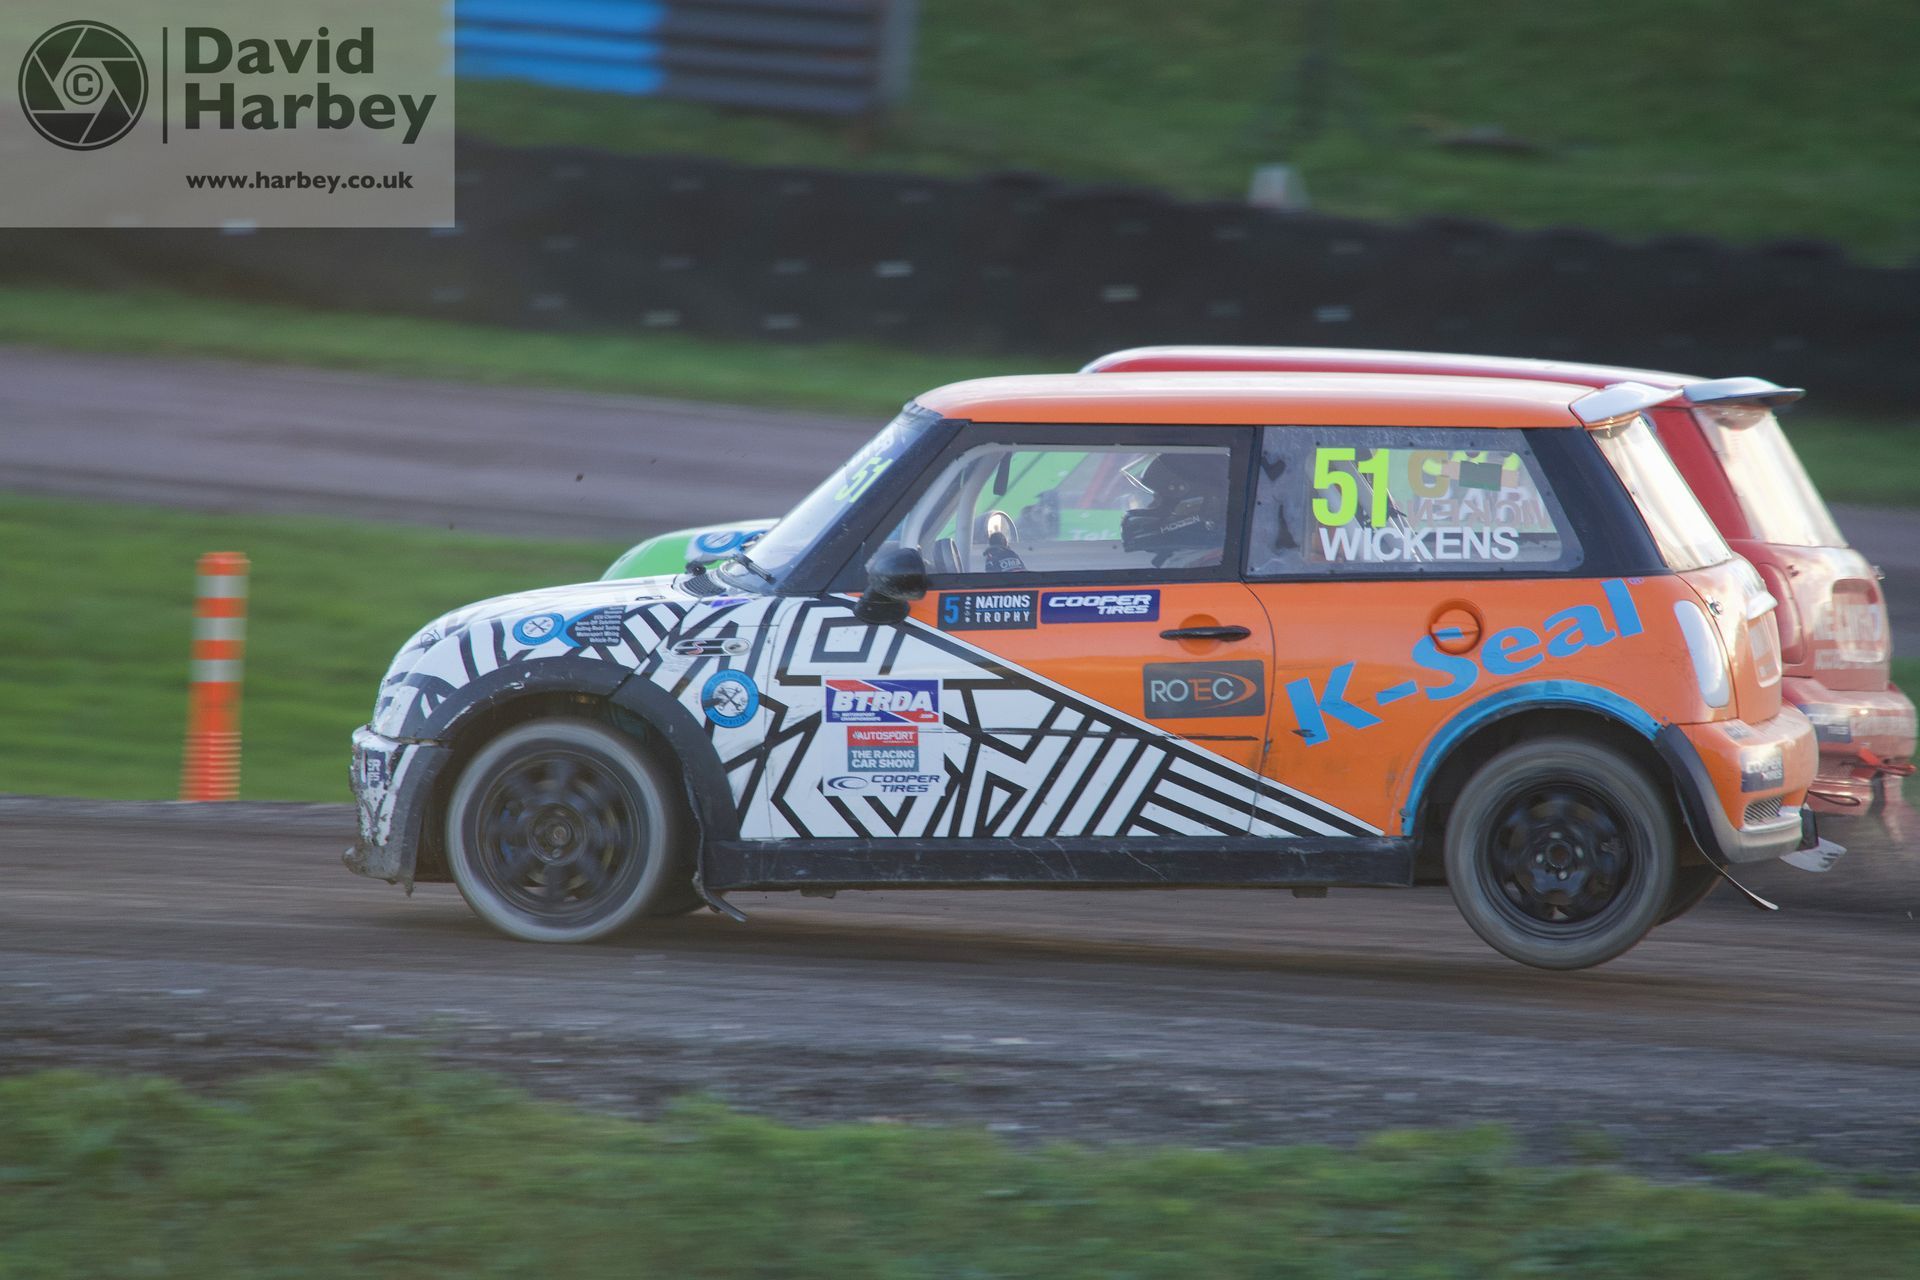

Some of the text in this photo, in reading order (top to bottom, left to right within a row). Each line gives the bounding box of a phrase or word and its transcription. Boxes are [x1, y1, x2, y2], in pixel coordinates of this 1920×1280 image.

[1312, 448, 1389, 528] 51
[1319, 526, 1519, 562] WICKENS
[976, 595, 1031, 609] NATIONS
[1049, 594, 1152, 607] COOPER
[944, 596, 960, 624] 5
[1097, 605, 1149, 615] TIRES
[976, 611, 1031, 623] TROPHY
[1285, 578, 1644, 747] K-Seal
[1150, 677, 1234, 703] ROTEC
[832, 690, 934, 712] BTRDA
[855, 731, 914, 741] AUTOSPORT
[851, 750, 915, 759] THE RACING
[851, 759, 915, 769] CAR SHOW
[871, 775, 940, 783] COOPER
[881, 784, 929, 792] TIRES
